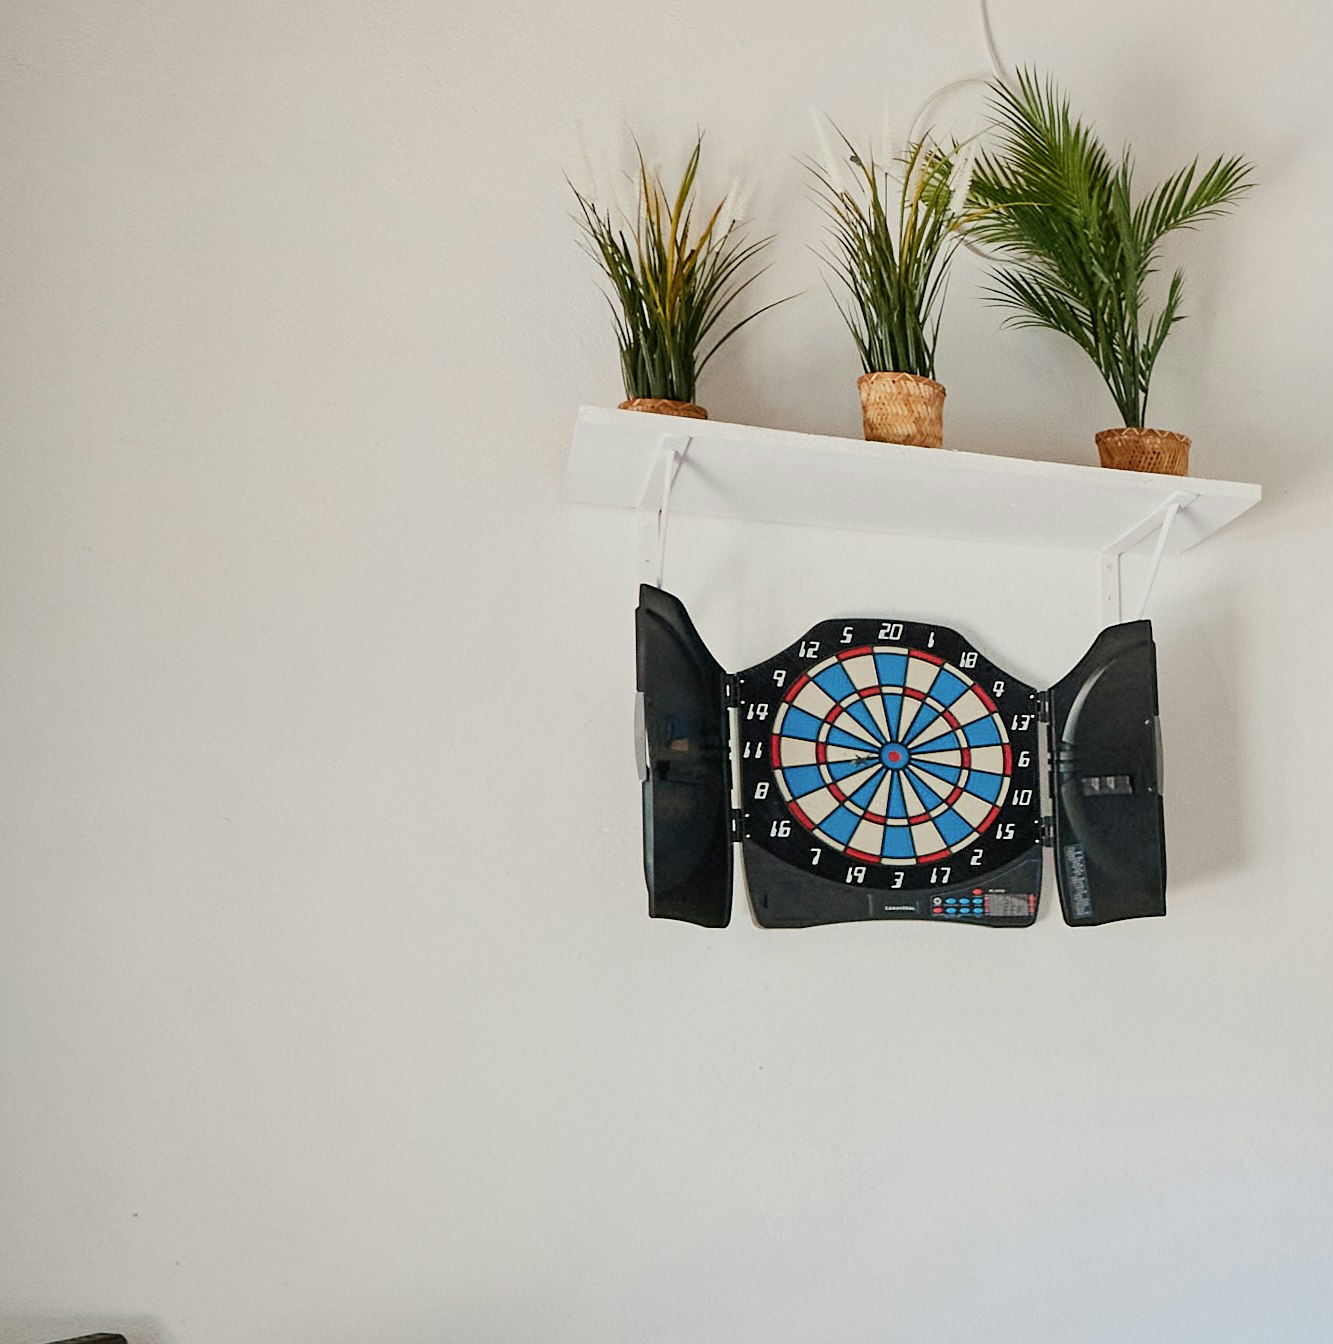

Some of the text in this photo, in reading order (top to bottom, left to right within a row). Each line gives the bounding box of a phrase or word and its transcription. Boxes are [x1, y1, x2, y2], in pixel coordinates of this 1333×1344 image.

[841, 627, 853, 644] 5
[879, 623, 902, 640] 20
[928, 632, 935, 647] 1
[800, 642, 819, 658] 12
[960, 652, 976, 668] 18
[774, 671, 786, 686] 9
[993, 682, 1005, 697] 4
[748, 704, 768, 720] 14
[1012, 715, 1029, 730] 13
[743, 742, 762, 758] 11
[1018, 751, 1029, 767] 6
[755, 783, 767, 799] 8
[1013, 789, 1031, 805] 10
[771, 820, 790, 837] 16
[997, 823, 1014, 840] 15
[810, 849, 821, 864] 7
[971, 849, 983, 865] 2
[847, 867, 865, 883] 19
[891, 872, 903, 888] 3
[931, 867, 951, 883] 17
